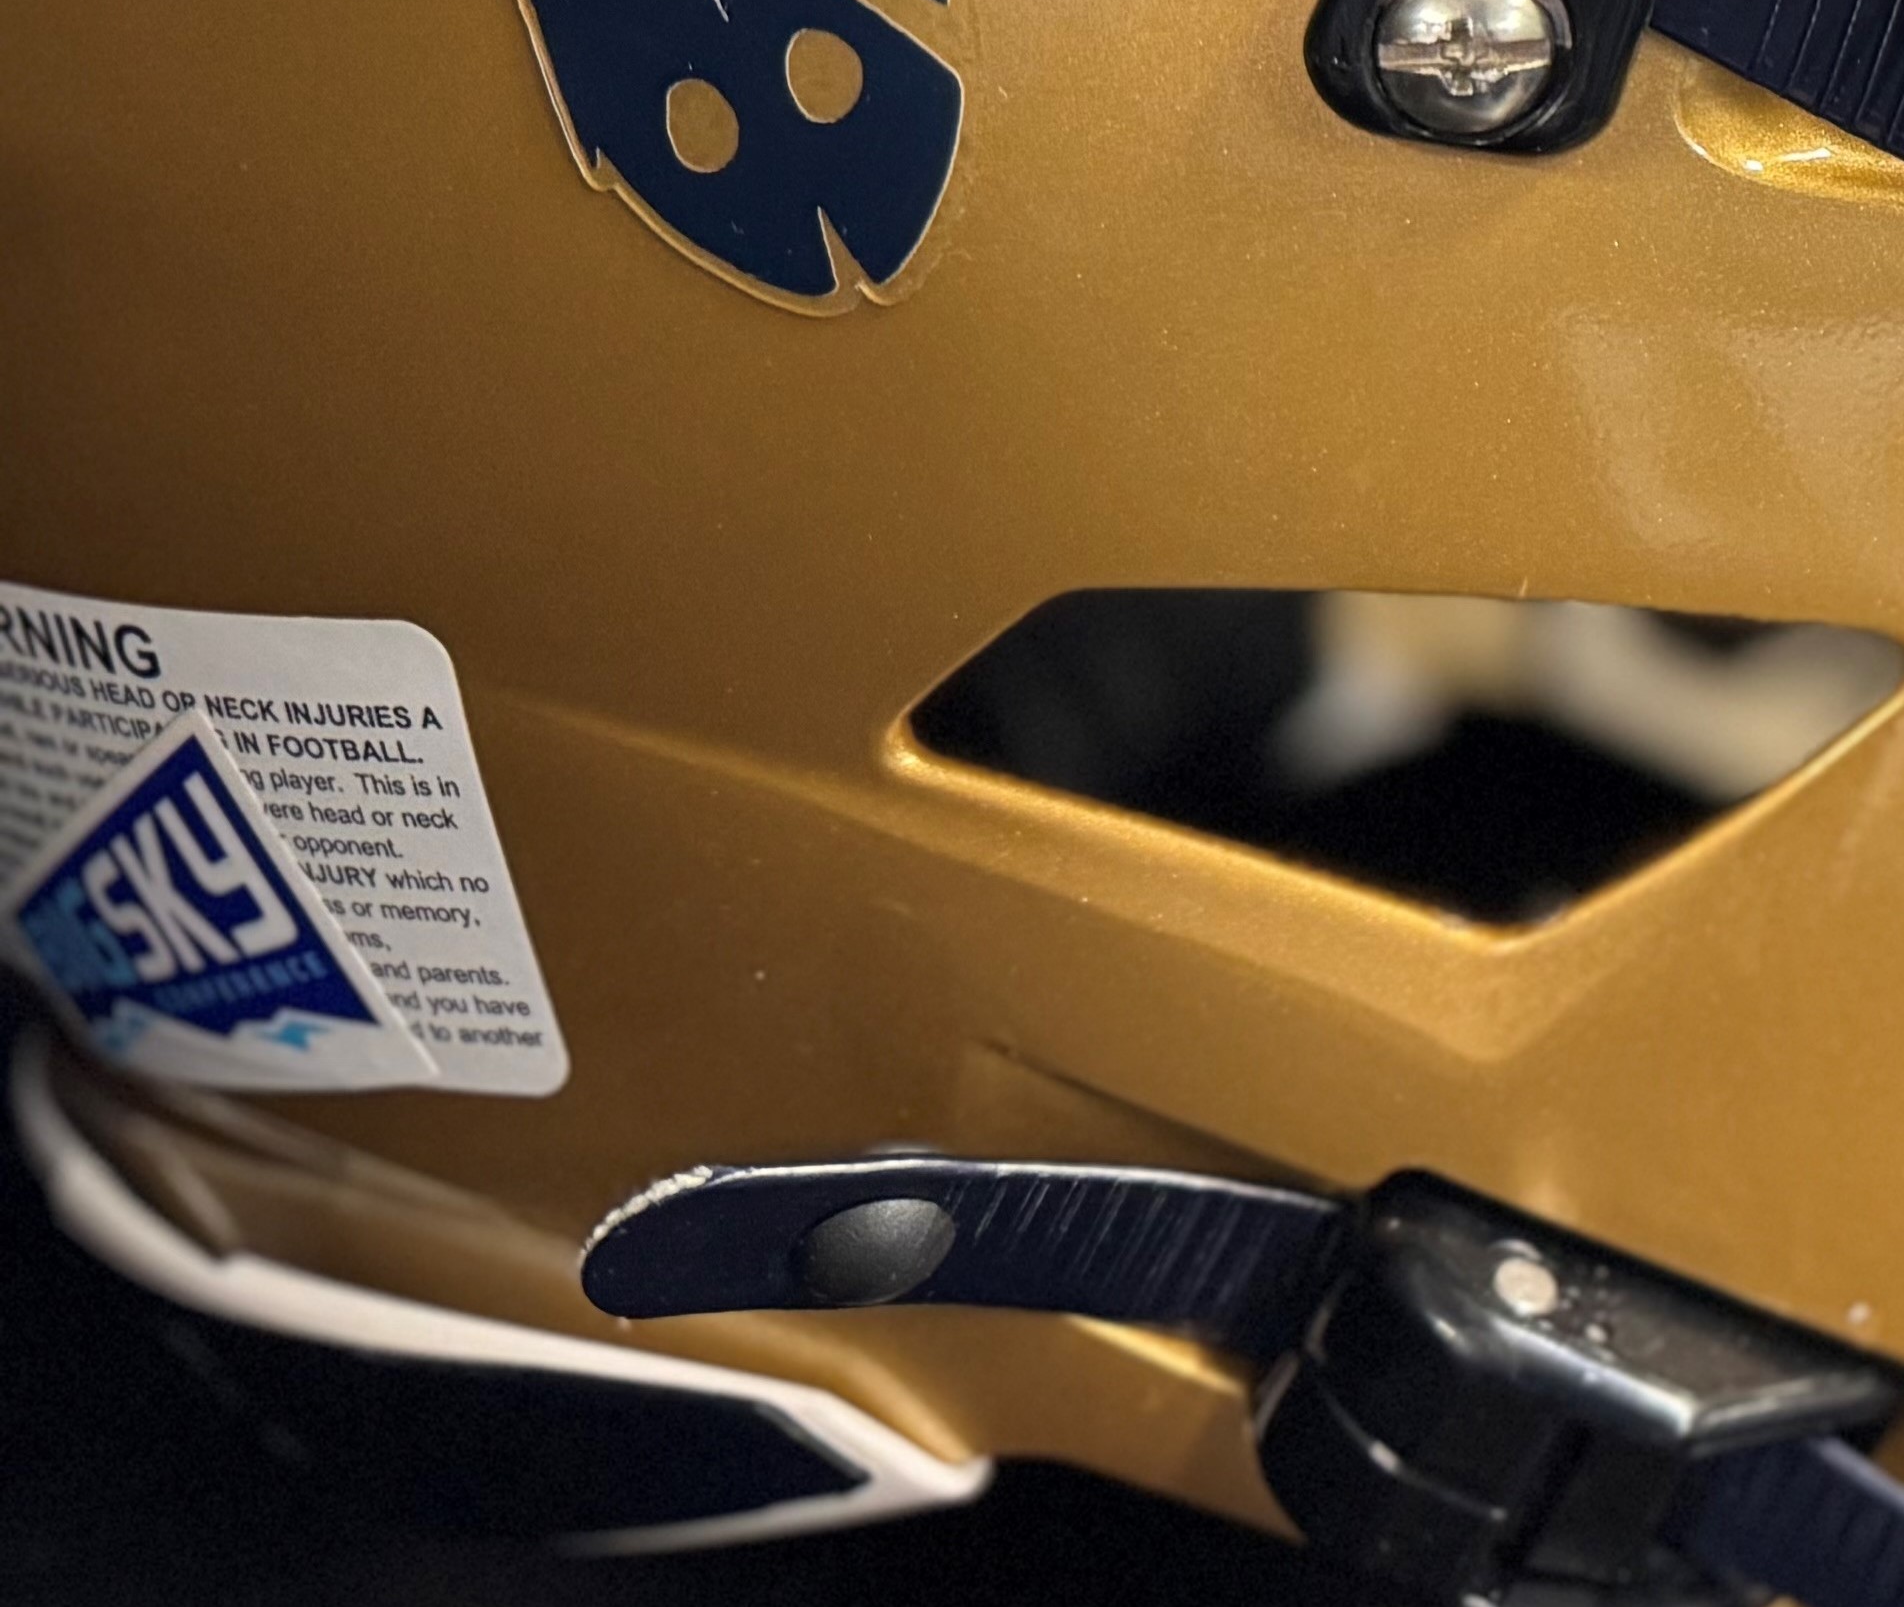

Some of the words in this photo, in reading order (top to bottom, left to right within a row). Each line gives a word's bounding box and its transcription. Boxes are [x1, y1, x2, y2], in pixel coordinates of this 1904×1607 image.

[89, 678, 156, 710] HEAD
[204, 693, 279, 723] NECK
[284, 701, 412, 729] INJURIES
[422, 706, 443, 730] A
[234, 730, 261, 755] IN
[267, 733, 424, 764] FOOTBALL.
[269, 767, 344, 795] player.
[355, 773, 406, 796] This
[412, 773, 432, 798] is
[438, 774, 460, 798] in
[308, 800, 365, 826] head
[371, 809, 395, 827] or
[402, 808, 458, 829] neck
[292, 834, 403, 860] opponent.
[82, 770, 299, 983] SKY
[385, 869, 454, 892] which
[459, 876, 489, 893] no
[351, 901, 374, 919] or
[381, 904, 481, 928] memory,
[371, 962, 411, 980] and
[417, 965, 510, 987] parents.
[427, 997, 468, 1017] you
[473, 996, 531, 1017] have
[458, 1025, 542, 1047] another
